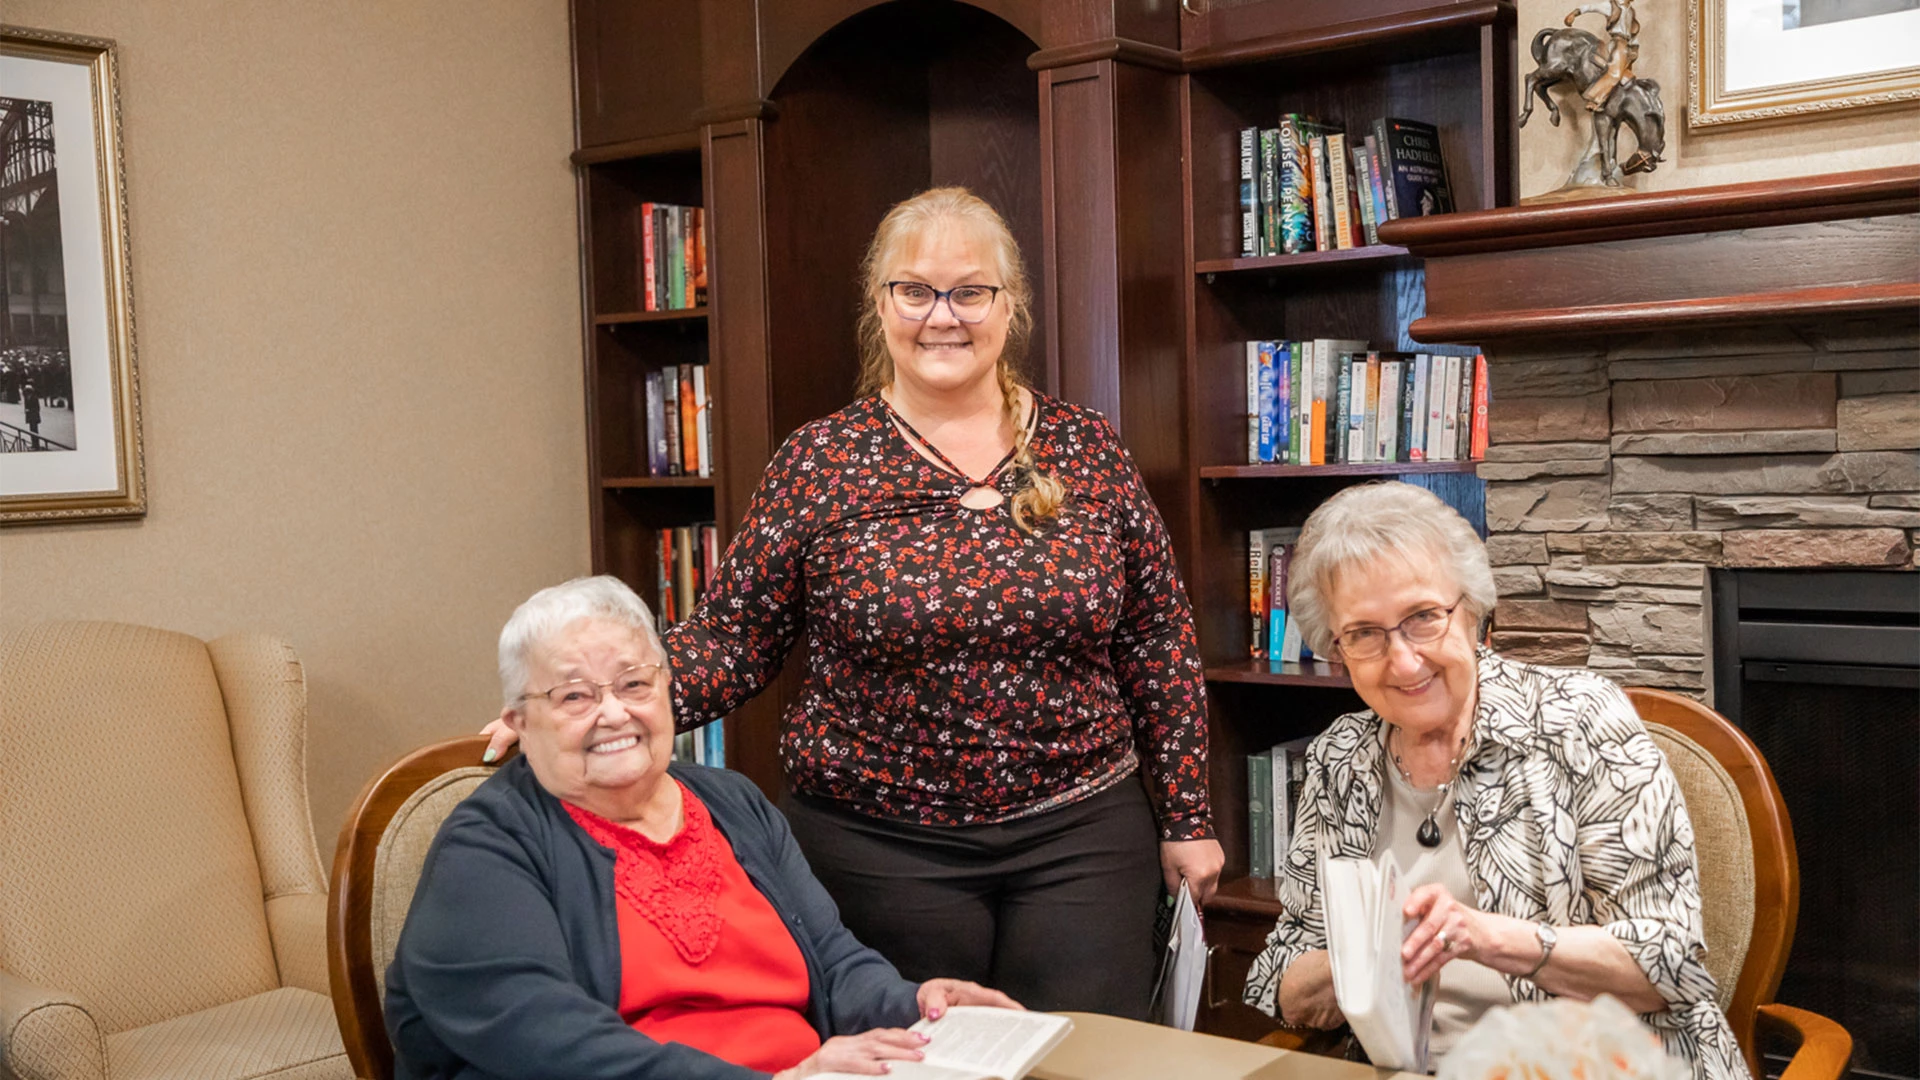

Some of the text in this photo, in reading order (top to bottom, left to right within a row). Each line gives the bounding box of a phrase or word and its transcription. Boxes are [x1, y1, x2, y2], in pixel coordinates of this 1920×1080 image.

[1395, 147, 1441, 164] HADFIELD
[1403, 134, 1431, 149] CHRIS
[1266, 170, 1275, 202] Parents
[1281, 120, 1293, 231] LOUISE PENNY
[1331, 143, 1345, 207] LISA SCOTTOLINE
[1250, 550, 1262, 593] Reichs
[1274, 558, 1282, 575] JODI
